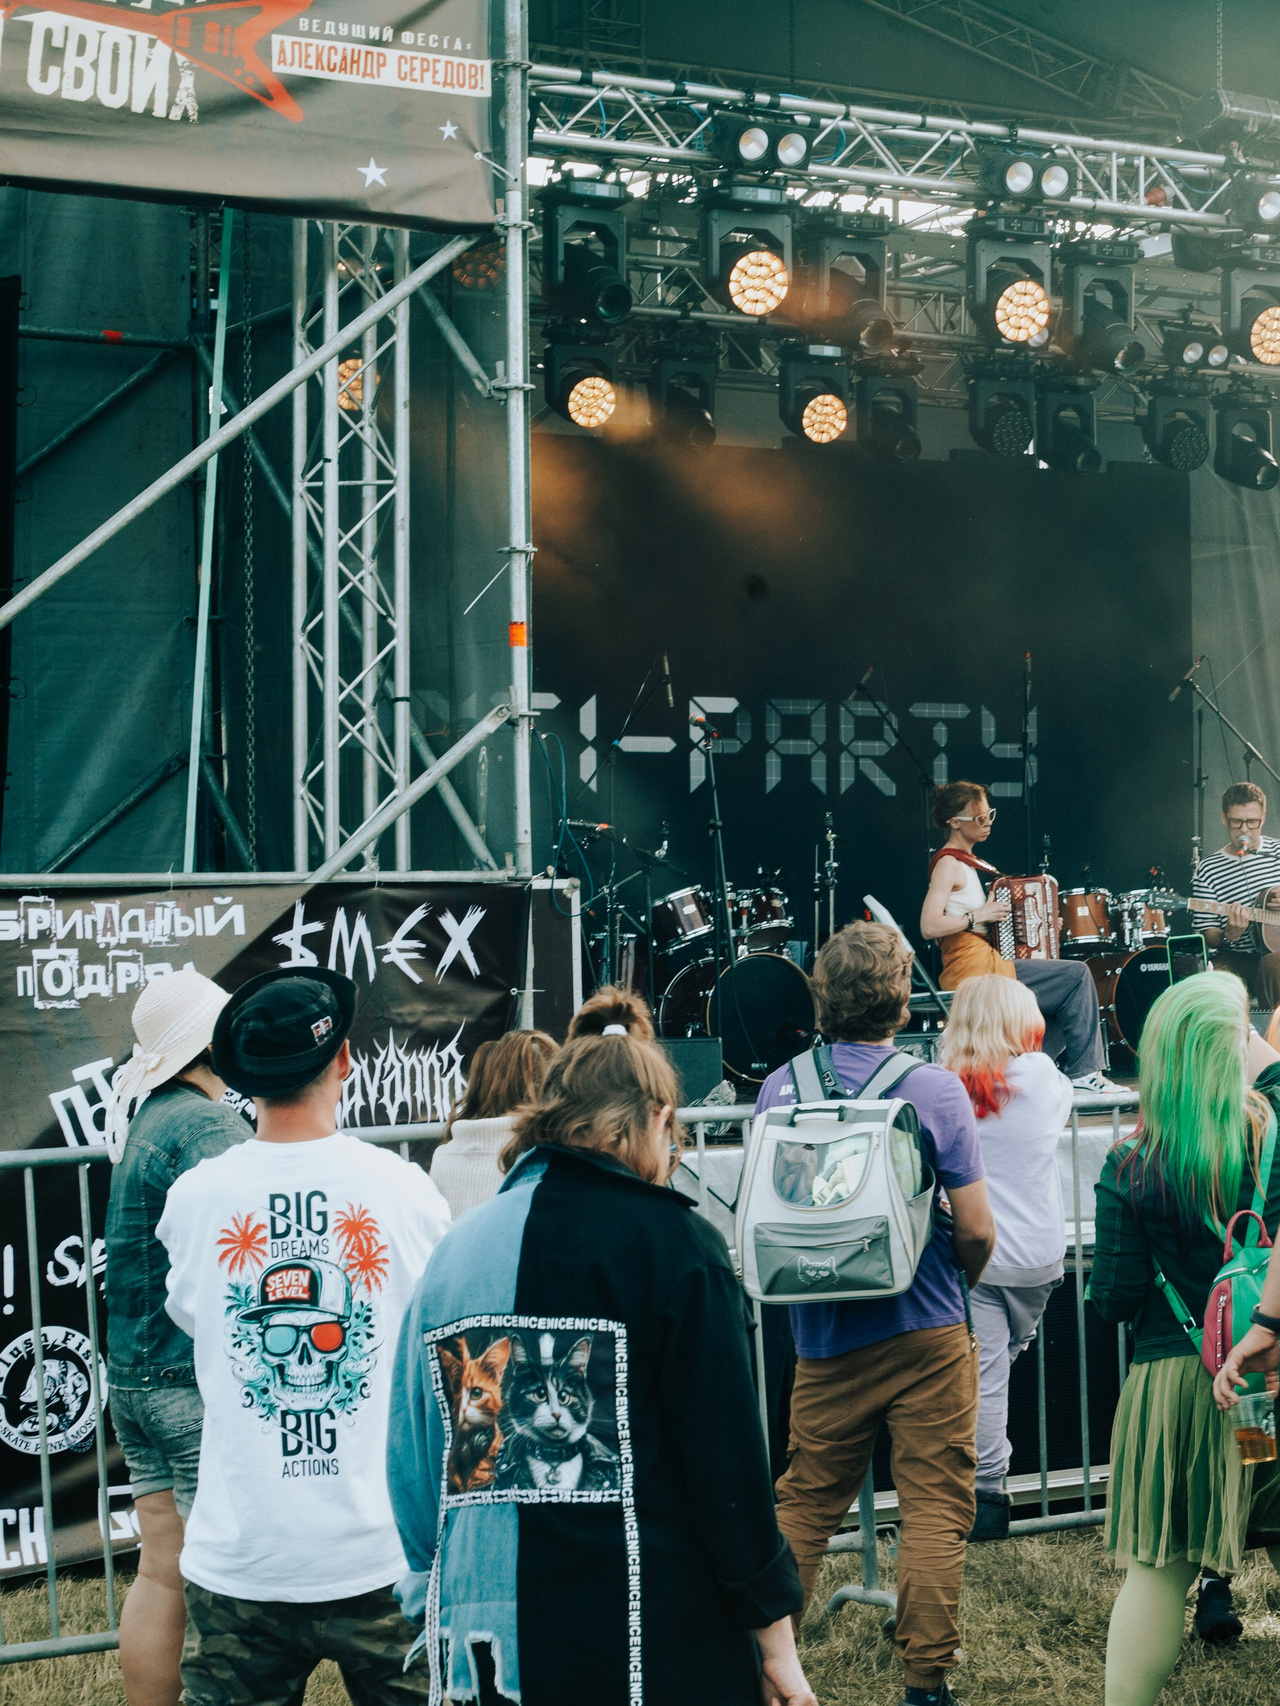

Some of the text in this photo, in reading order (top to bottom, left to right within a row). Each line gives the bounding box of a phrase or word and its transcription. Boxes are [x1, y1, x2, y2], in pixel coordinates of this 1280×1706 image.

[299, 16, 472, 52] ВЕДУЩИЙ ФЕСТА:
[276, 40, 486, 92] АЛЕКСАНДР СЕРЕДОВ!
[17, 952, 196, 1003] ПОДР
[269, 1190, 329, 1240] BIG
[271, 1238, 330, 1258] DREAMS
[265, 1269, 310, 1292] SEVEN
[268, 1286, 309, 1301] LEVEL
[279, 1408, 338, 1457] BIG
[281, 1458, 340, 1479] ACTIONS
